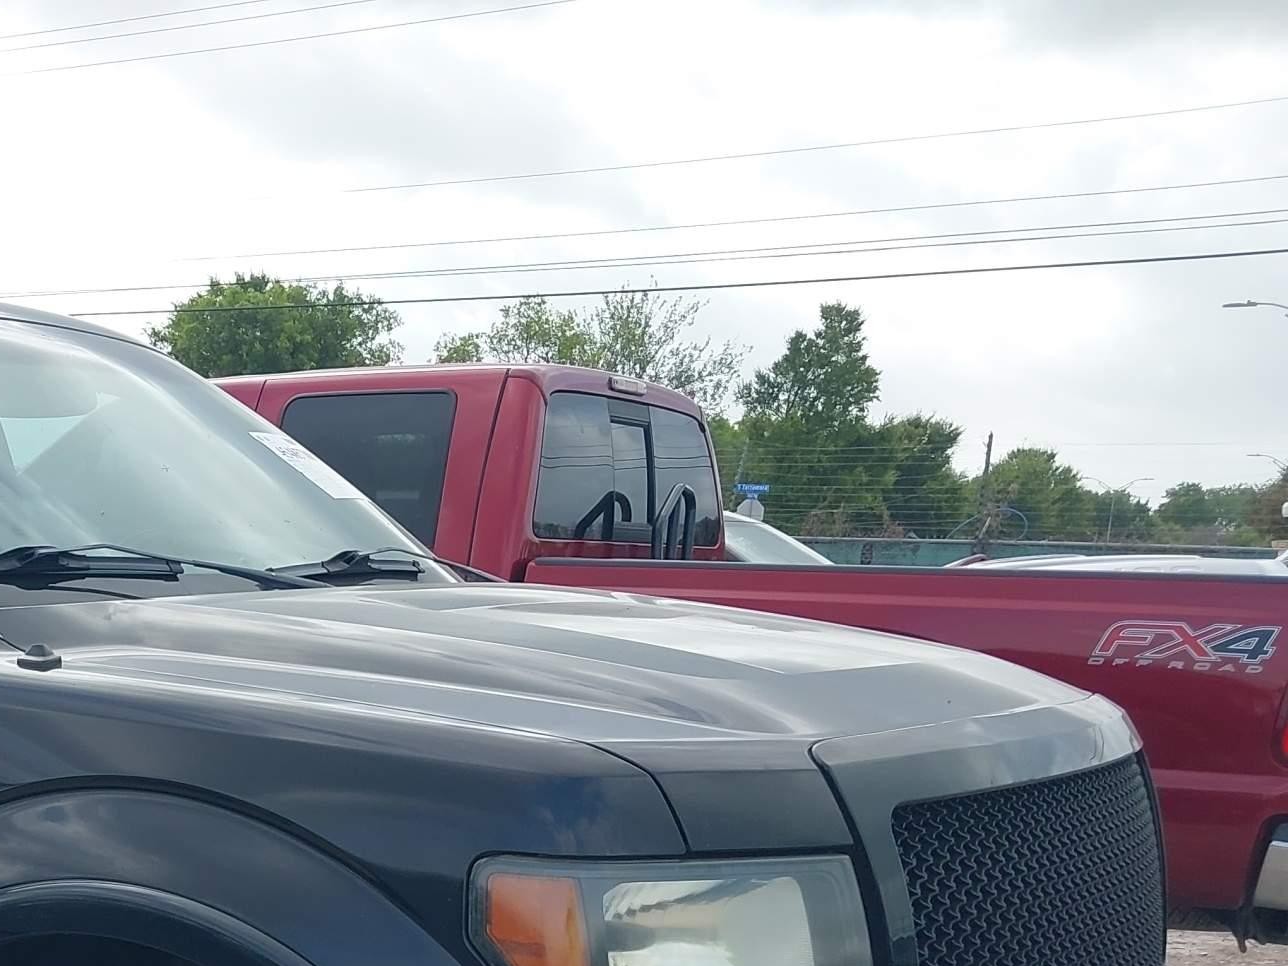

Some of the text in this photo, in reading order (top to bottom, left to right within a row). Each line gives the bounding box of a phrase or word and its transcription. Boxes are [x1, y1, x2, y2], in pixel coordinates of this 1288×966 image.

[1092, 619, 1283, 664] FX4
[1087, 657, 1264, 674] OFF ROAD
